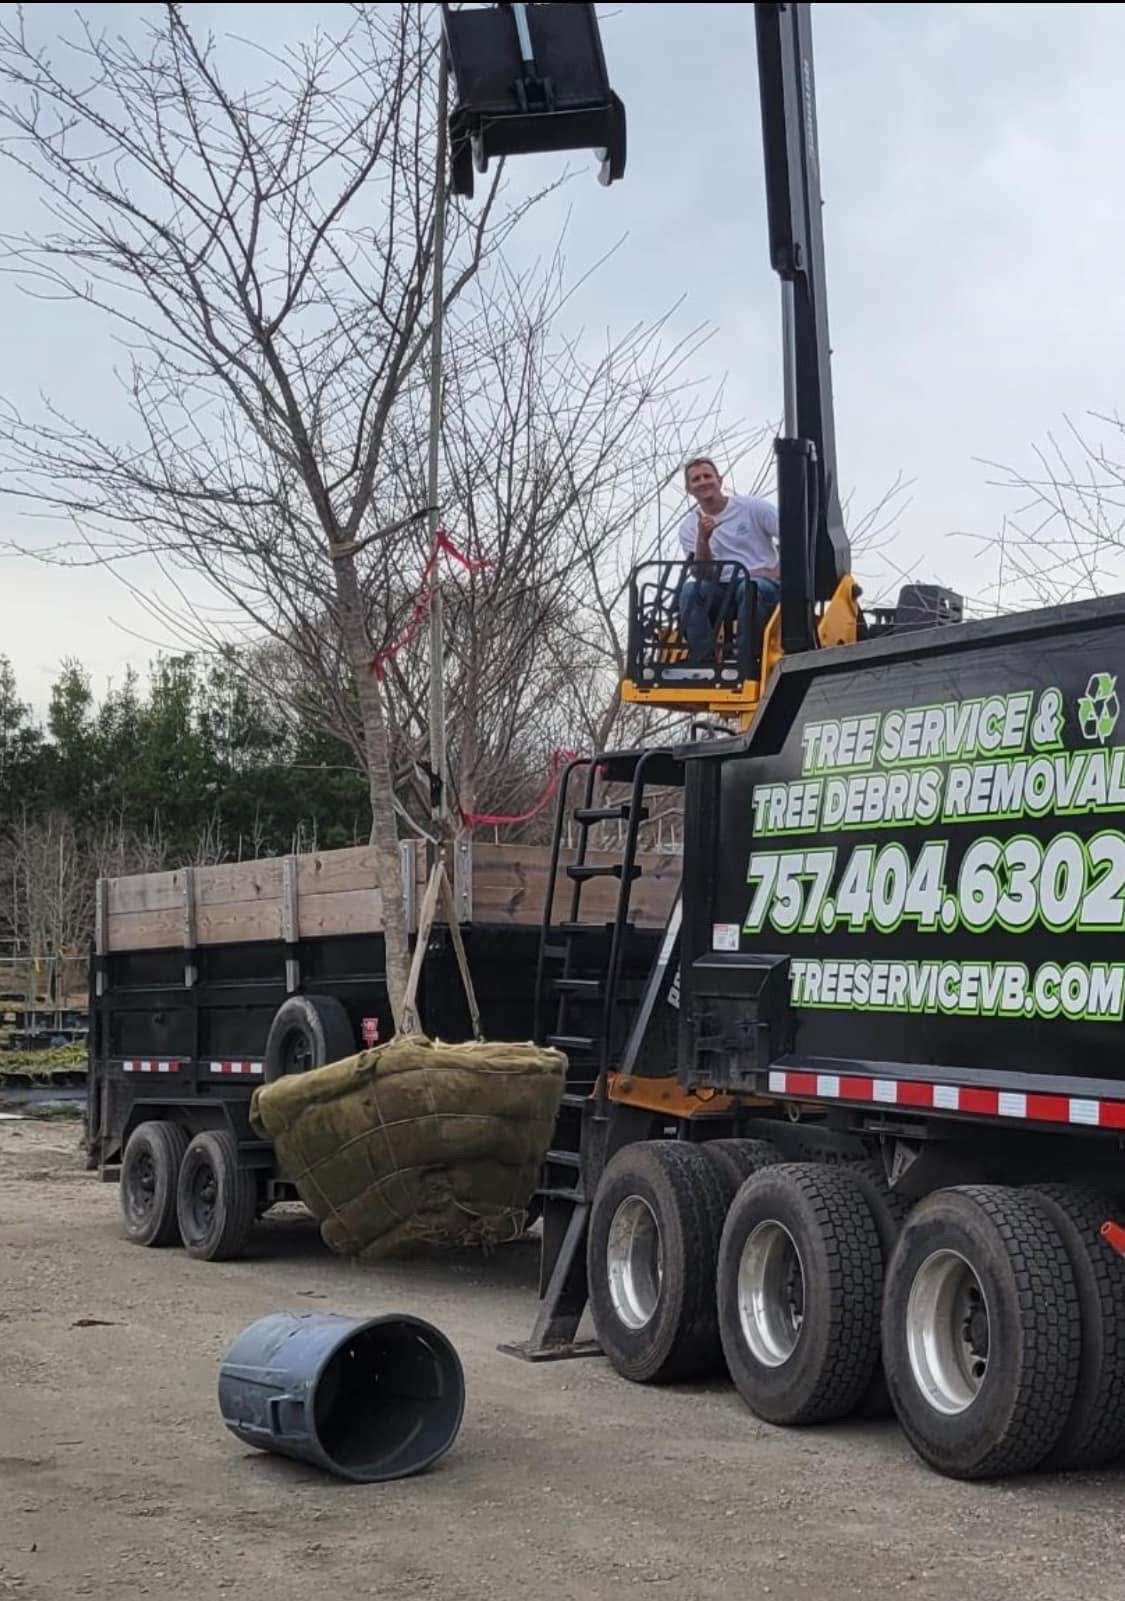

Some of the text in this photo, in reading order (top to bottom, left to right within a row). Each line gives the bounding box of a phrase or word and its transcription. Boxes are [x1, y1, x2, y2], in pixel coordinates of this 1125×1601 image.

[803, 690, 1063, 772] TREE SERVICE &
[755, 750, 1125, 833] TREE DEBRIS REMOVAL
[745, 832, 1125, 930] 757.404.6302
[791, 962, 1125, 1017] TREESERVICEVB.COM
